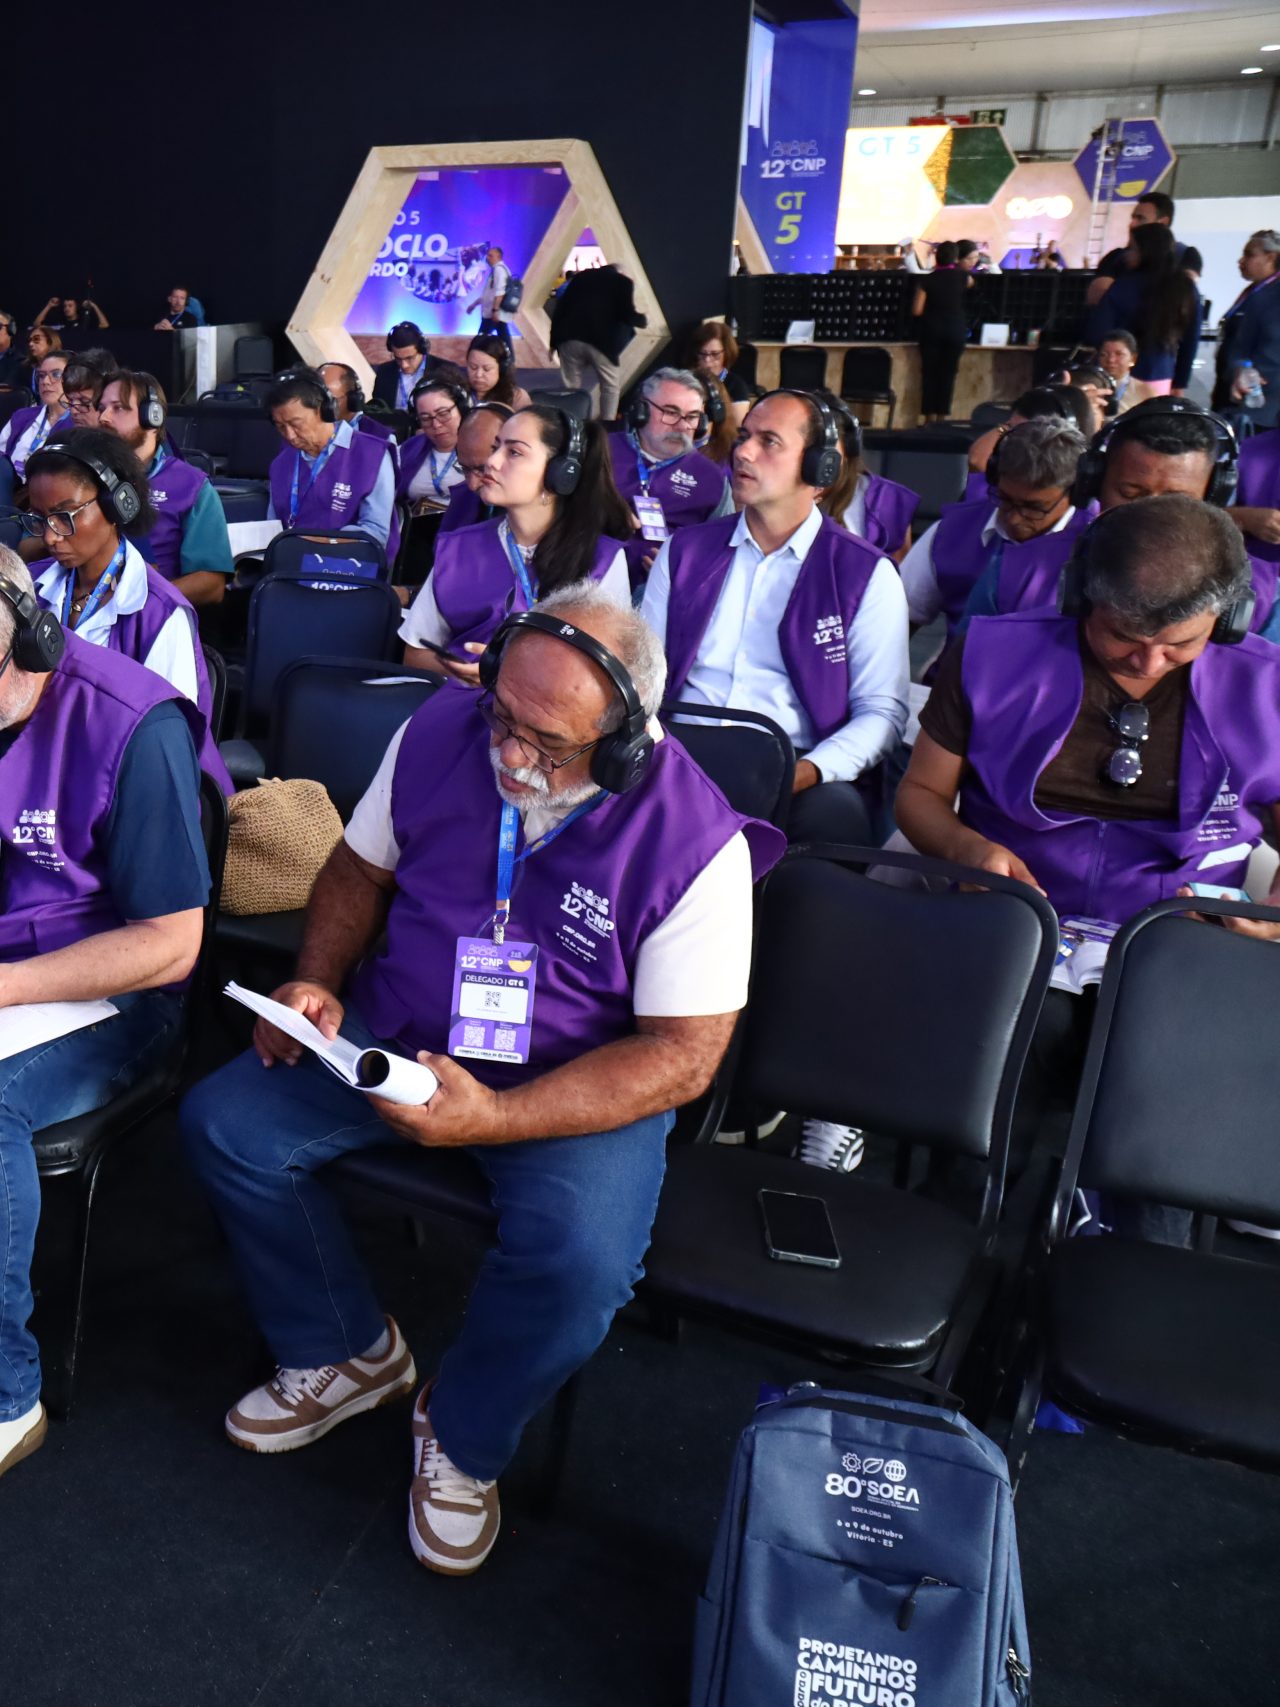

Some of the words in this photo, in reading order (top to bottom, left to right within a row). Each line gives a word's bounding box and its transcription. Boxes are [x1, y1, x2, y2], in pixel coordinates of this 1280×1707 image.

[859, 136, 895, 156] GT
[907, 136, 920, 155] 5
[776, 191, 807, 211] GT
[410, 210, 421, 226] 5
[775, 214, 802, 245] 5
[13, 825, 56, 844] 12°CN
[465, 974, 504, 985] DELEGADO
[837, 1519, 843, 1527] 6
[852, 1521, 859, 1529] 9
[860, 1524, 871, 1532] de
[872, 1526, 904, 1540] outubro
[846, 1530, 876, 1543] Vitória
[882, 1538, 894, 1548] ES
[799, 1637, 918, 1675] PROJETANDO
[797, 1651, 917, 1693] CAMINHOS
[812, 1672, 916, 1707] FUTURO
